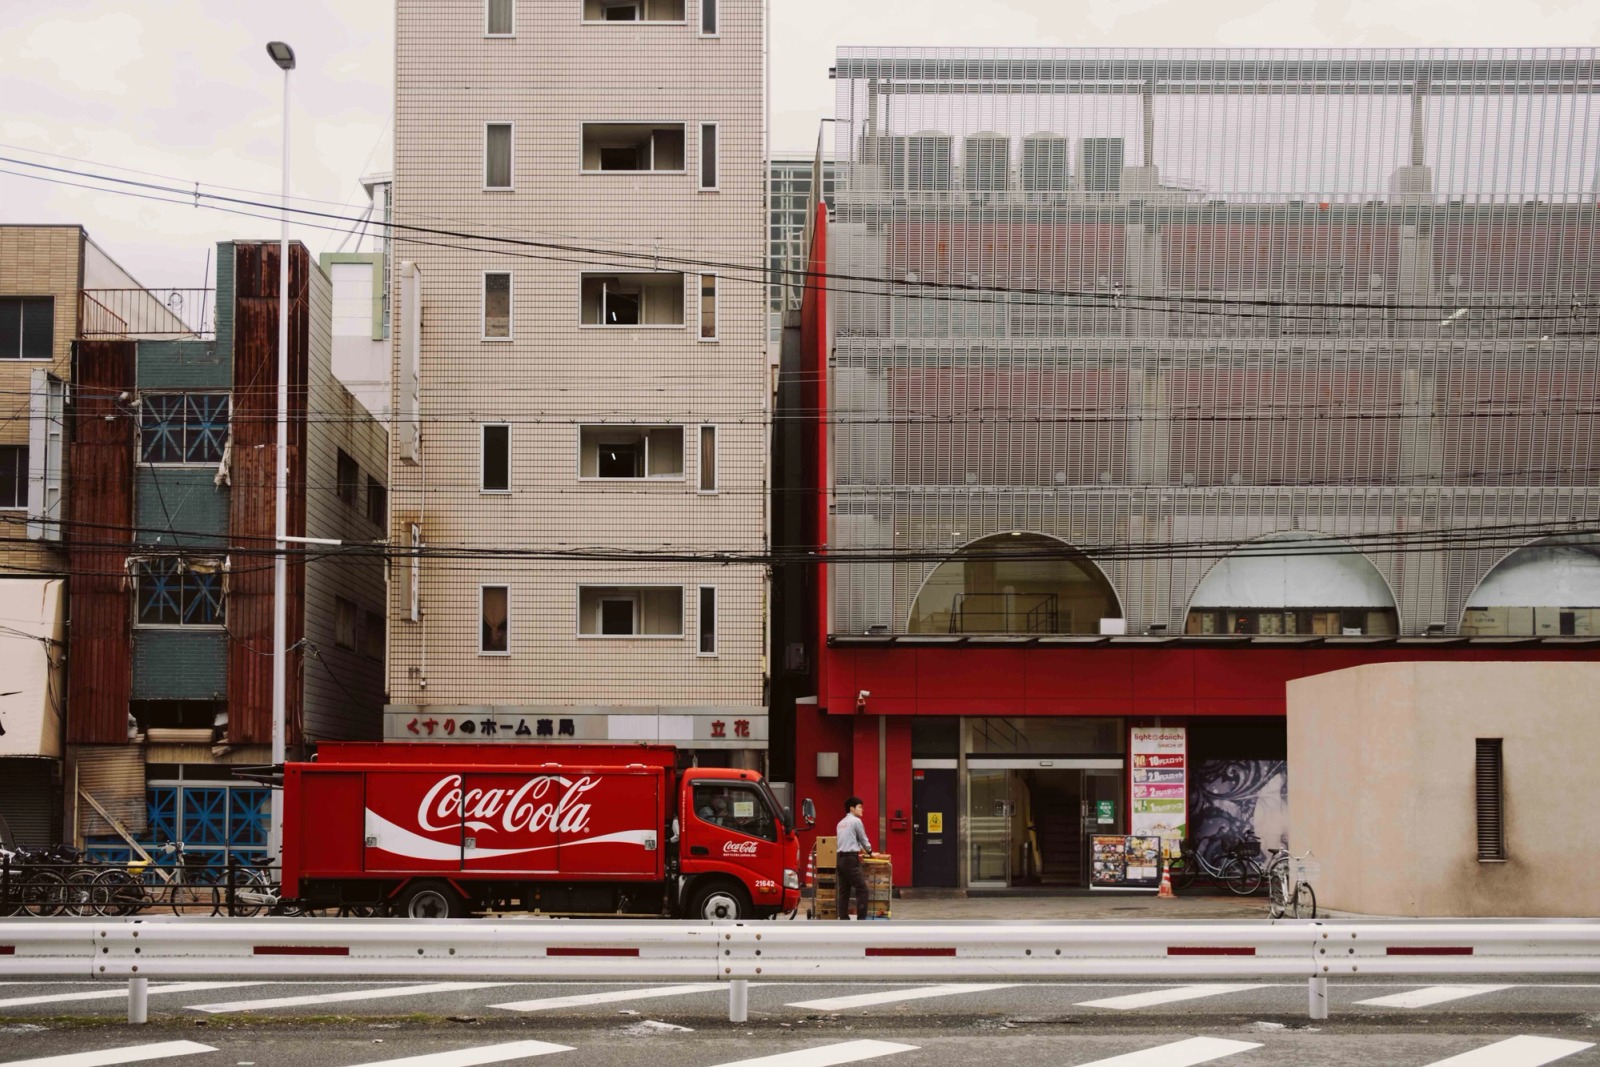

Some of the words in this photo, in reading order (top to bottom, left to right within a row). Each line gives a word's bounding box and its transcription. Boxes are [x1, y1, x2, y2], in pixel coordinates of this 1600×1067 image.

[711, 719, 750, 738] 立花
[417, 774, 602, 833] Coca-Cola
[723, 841, 758, 853] Coca-Cola
